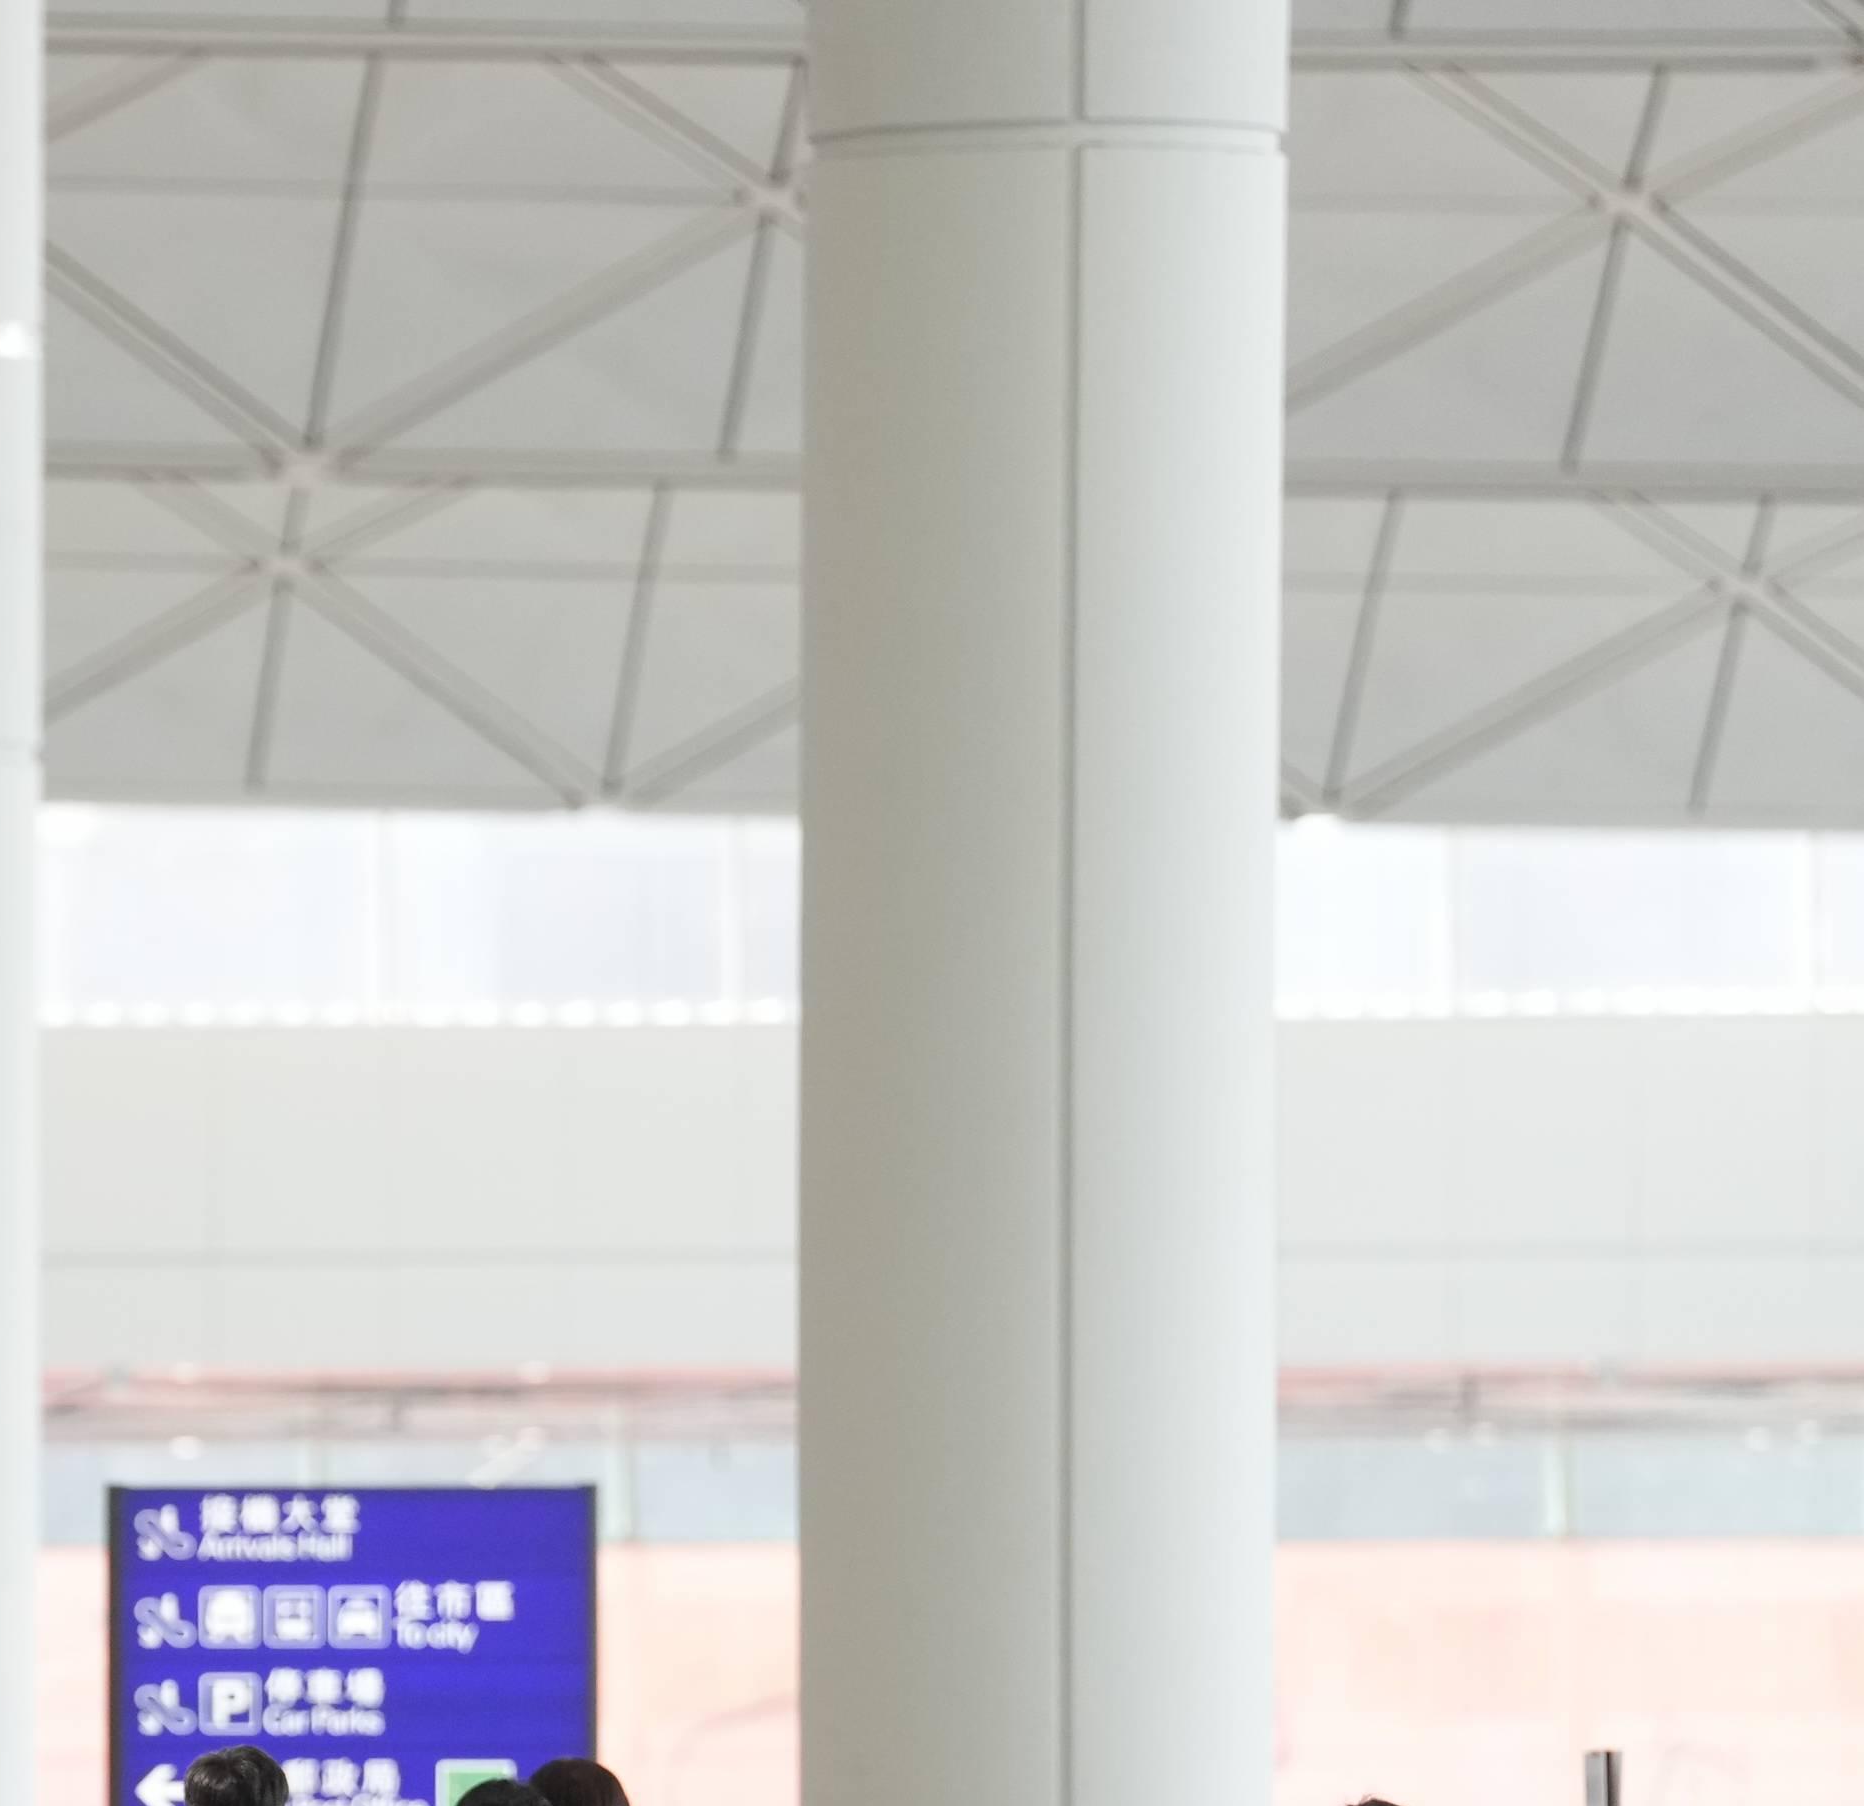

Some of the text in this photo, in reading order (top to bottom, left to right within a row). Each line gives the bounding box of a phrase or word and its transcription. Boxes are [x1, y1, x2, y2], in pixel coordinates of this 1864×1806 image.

[196, 1531, 354, 1563] Arrivals Hall
[392, 1615, 480, 1654] To city
[211, 1678, 253, 1730] P
[262, 1703, 386, 1737] Car Parks
[280, 1757, 401, 1800] 郵政局
